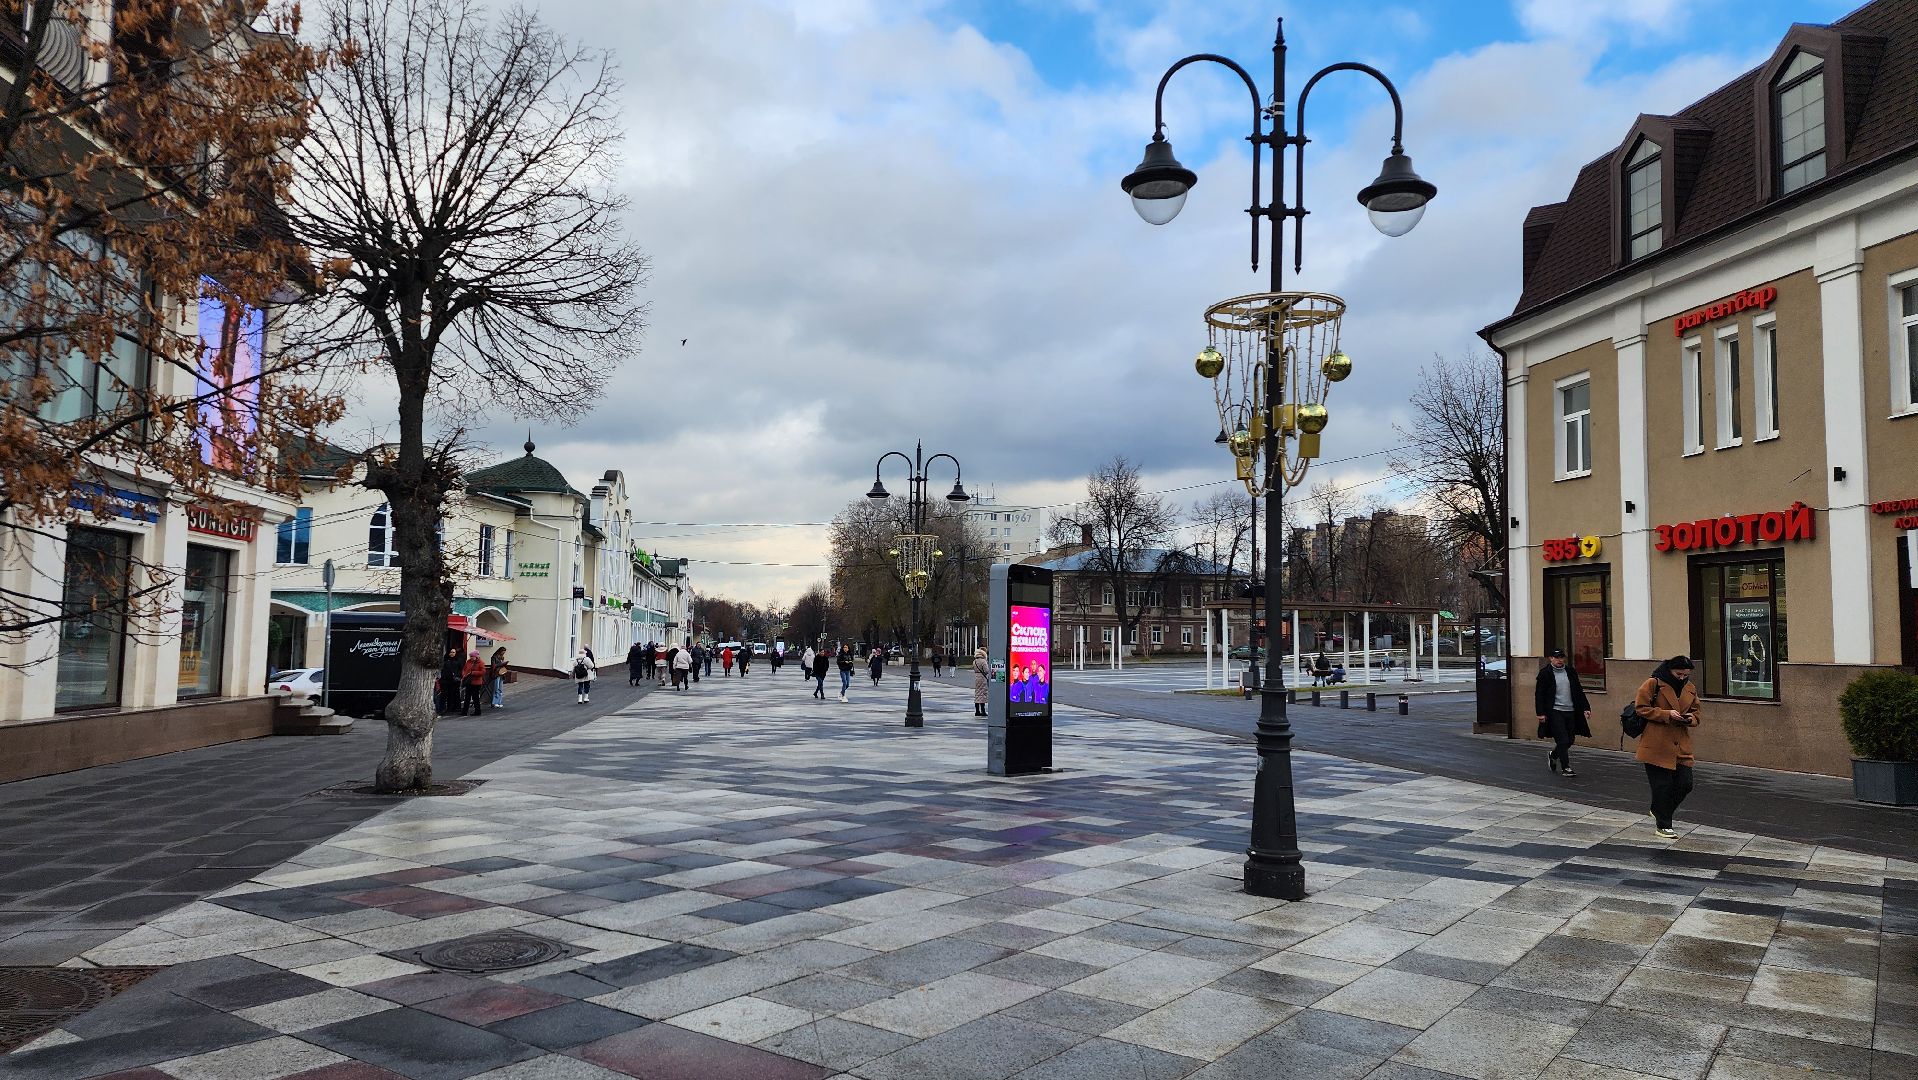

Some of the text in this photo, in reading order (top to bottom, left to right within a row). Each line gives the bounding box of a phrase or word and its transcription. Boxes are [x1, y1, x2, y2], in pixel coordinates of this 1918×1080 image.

[190, 508, 255, 538] SUNLIGHT
[1012, 513, 1031, 522] 1967
[1543, 502, 1815, 561] 585 ЗОЛОТОЙ
[1742, 582, 1768, 591] ОБМЕН
